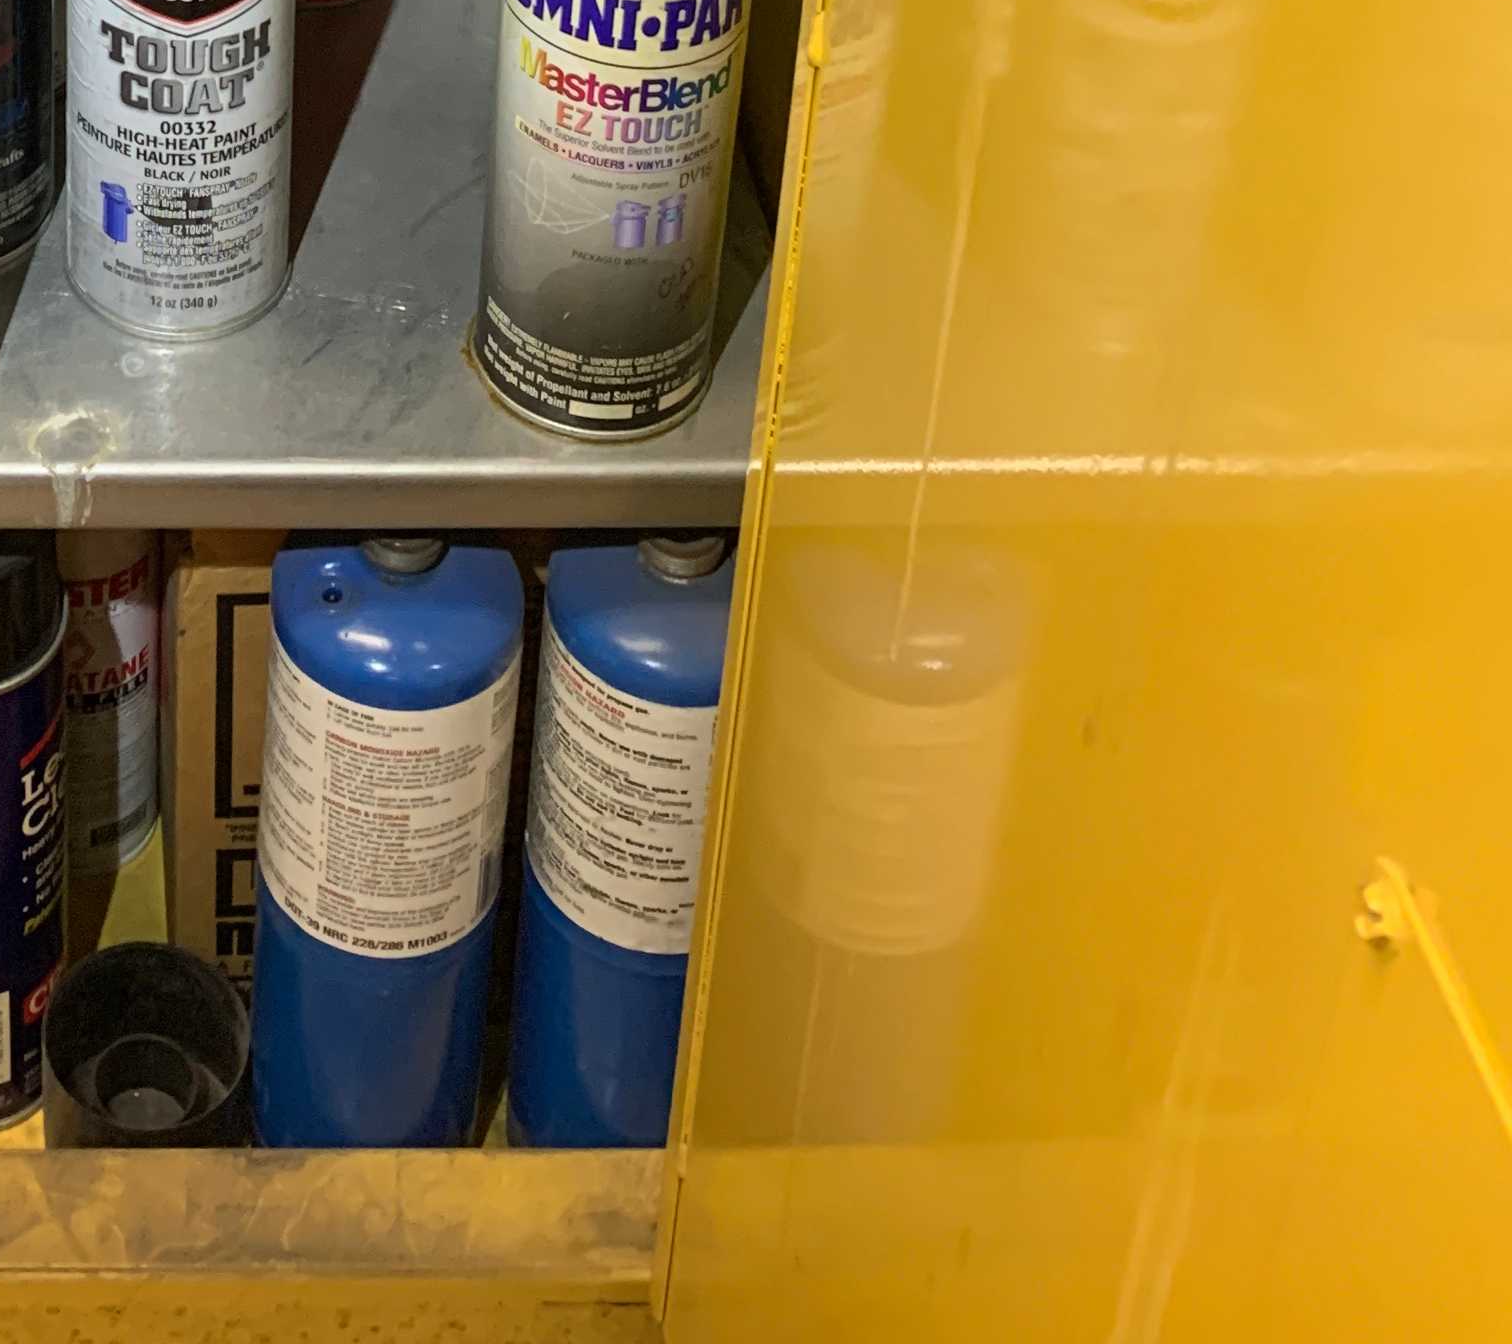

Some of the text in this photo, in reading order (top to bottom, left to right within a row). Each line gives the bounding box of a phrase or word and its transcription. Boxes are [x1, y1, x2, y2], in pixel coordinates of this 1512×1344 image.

[101, 18, 271, 76] TOUGH
[519, 34, 739, 113] MasterBlend
[120, 66, 254, 115] COAT
[117, 122, 257, 150] HIGH-HEAT PAINT
[160, 120, 217, 136] 00332
[556, 100, 703, 144] EZ TOUCH
[77, 112, 132, 158] PEINTURE
[136, 148, 196, 166] HAUTES
[518, 120, 625, 170] ENAMELS LACQUERS
[554, 125, 589, 149] Superior
[144, 166, 231, 181] BLACK NOIR
[536, 374, 610, 402] Propellant and
[540, 390, 566, 410] Paint
[322, 926, 350, 945] NRC
